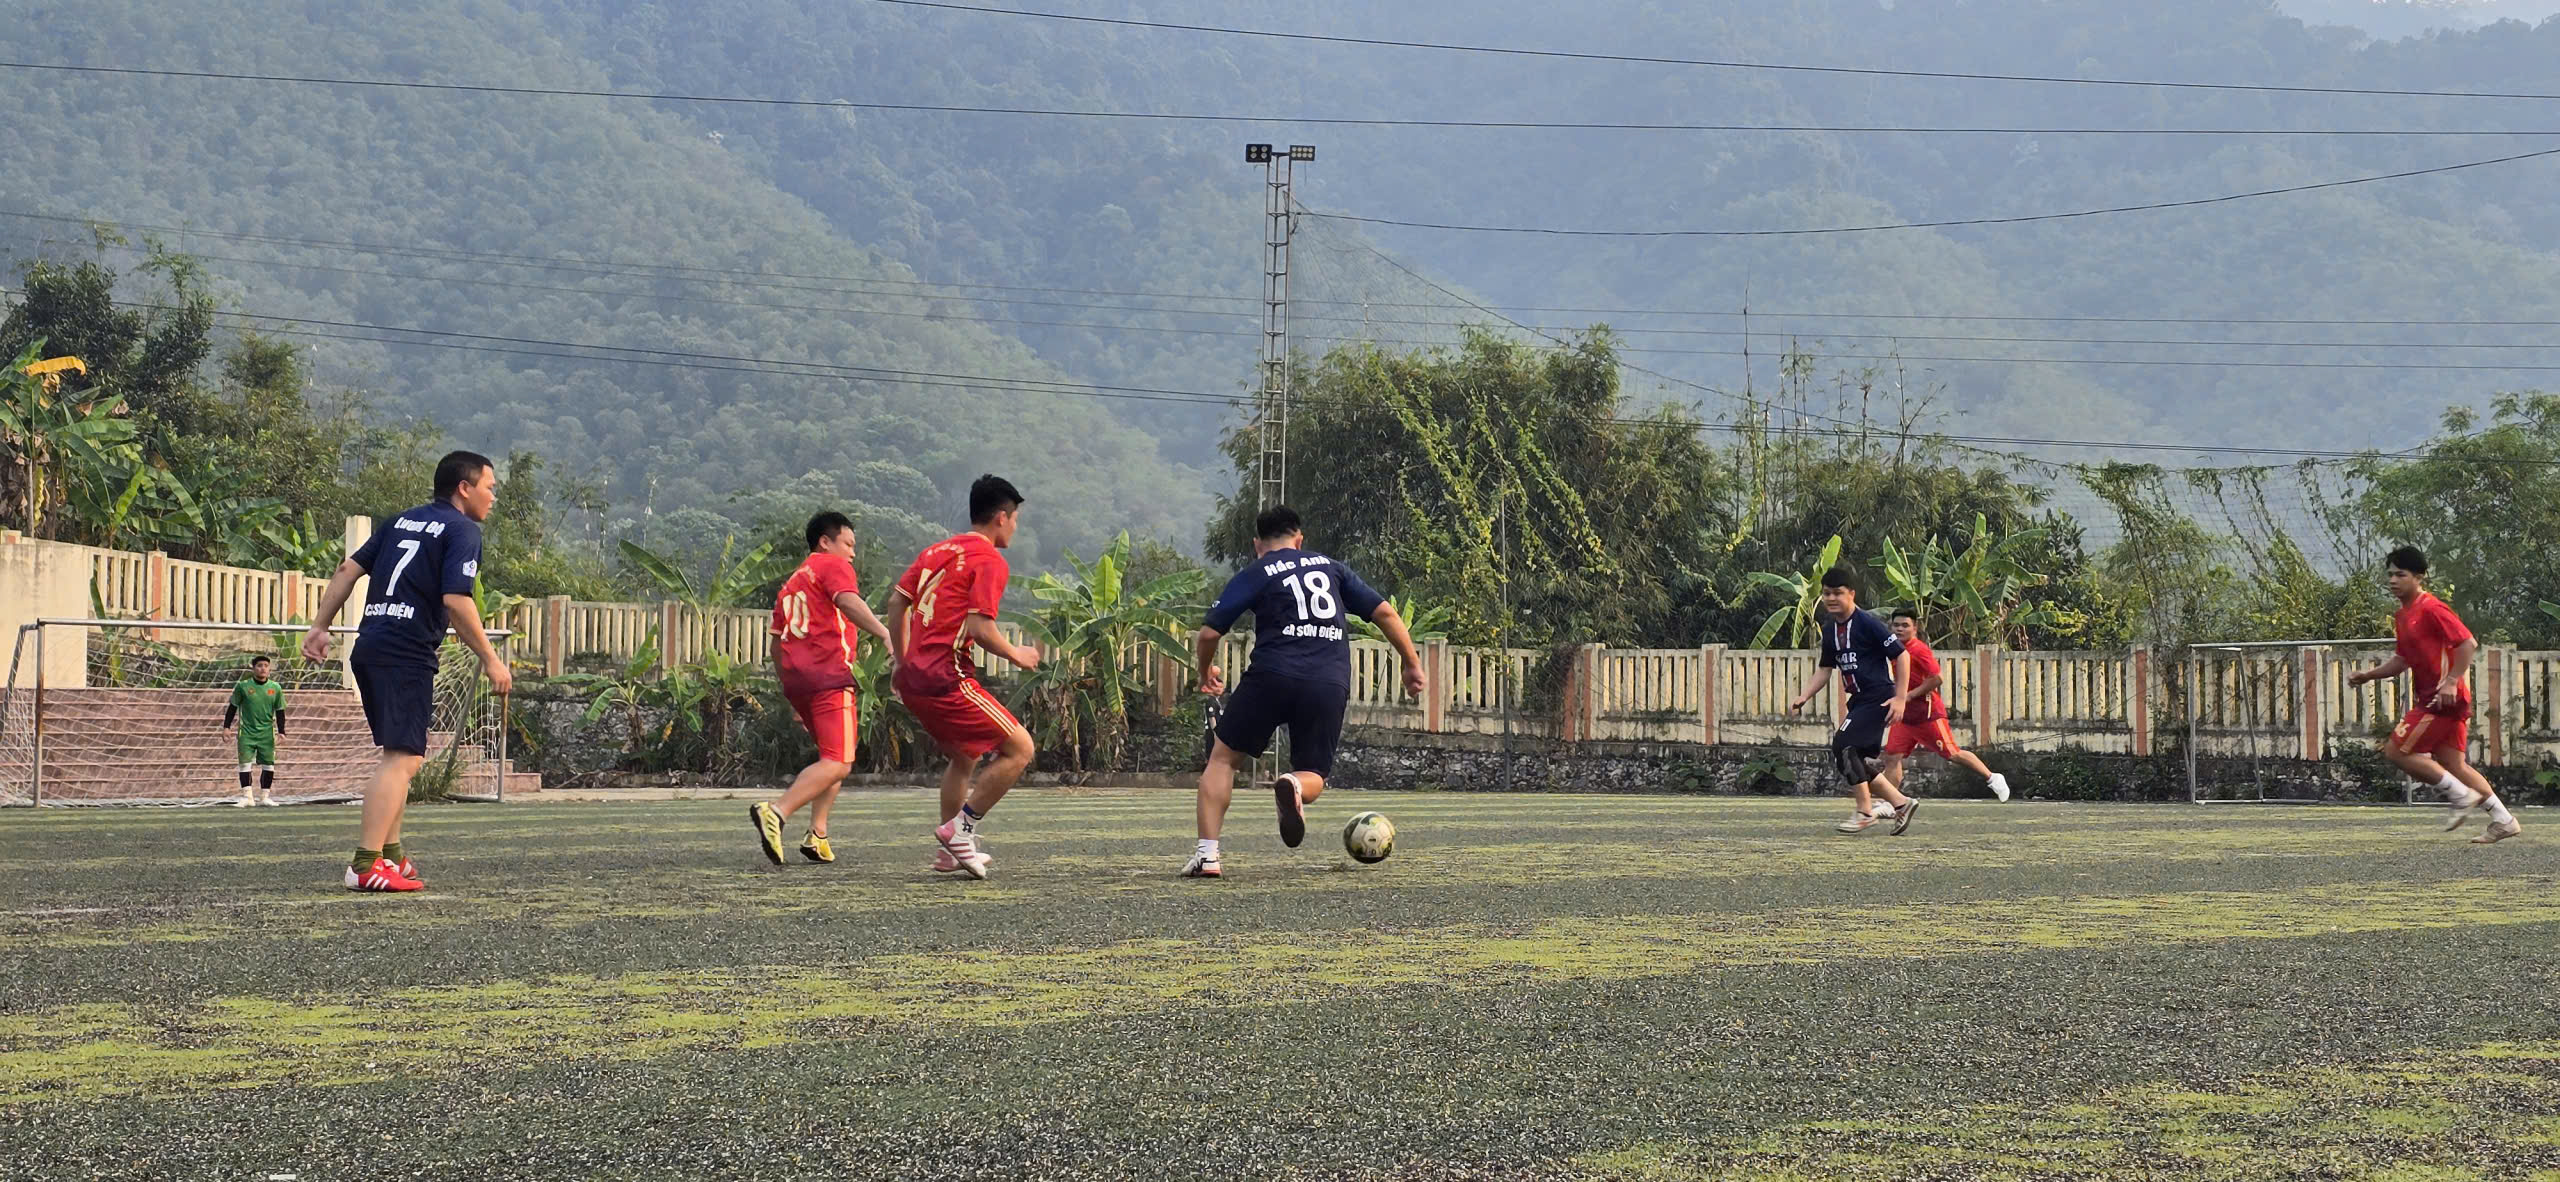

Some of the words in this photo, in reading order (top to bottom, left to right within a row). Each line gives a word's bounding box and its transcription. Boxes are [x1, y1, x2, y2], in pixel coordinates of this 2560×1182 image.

[386, 540, 420, 596] 7
[1300, 556, 1330, 567] Anh
[1282, 570, 1337, 620] 18
